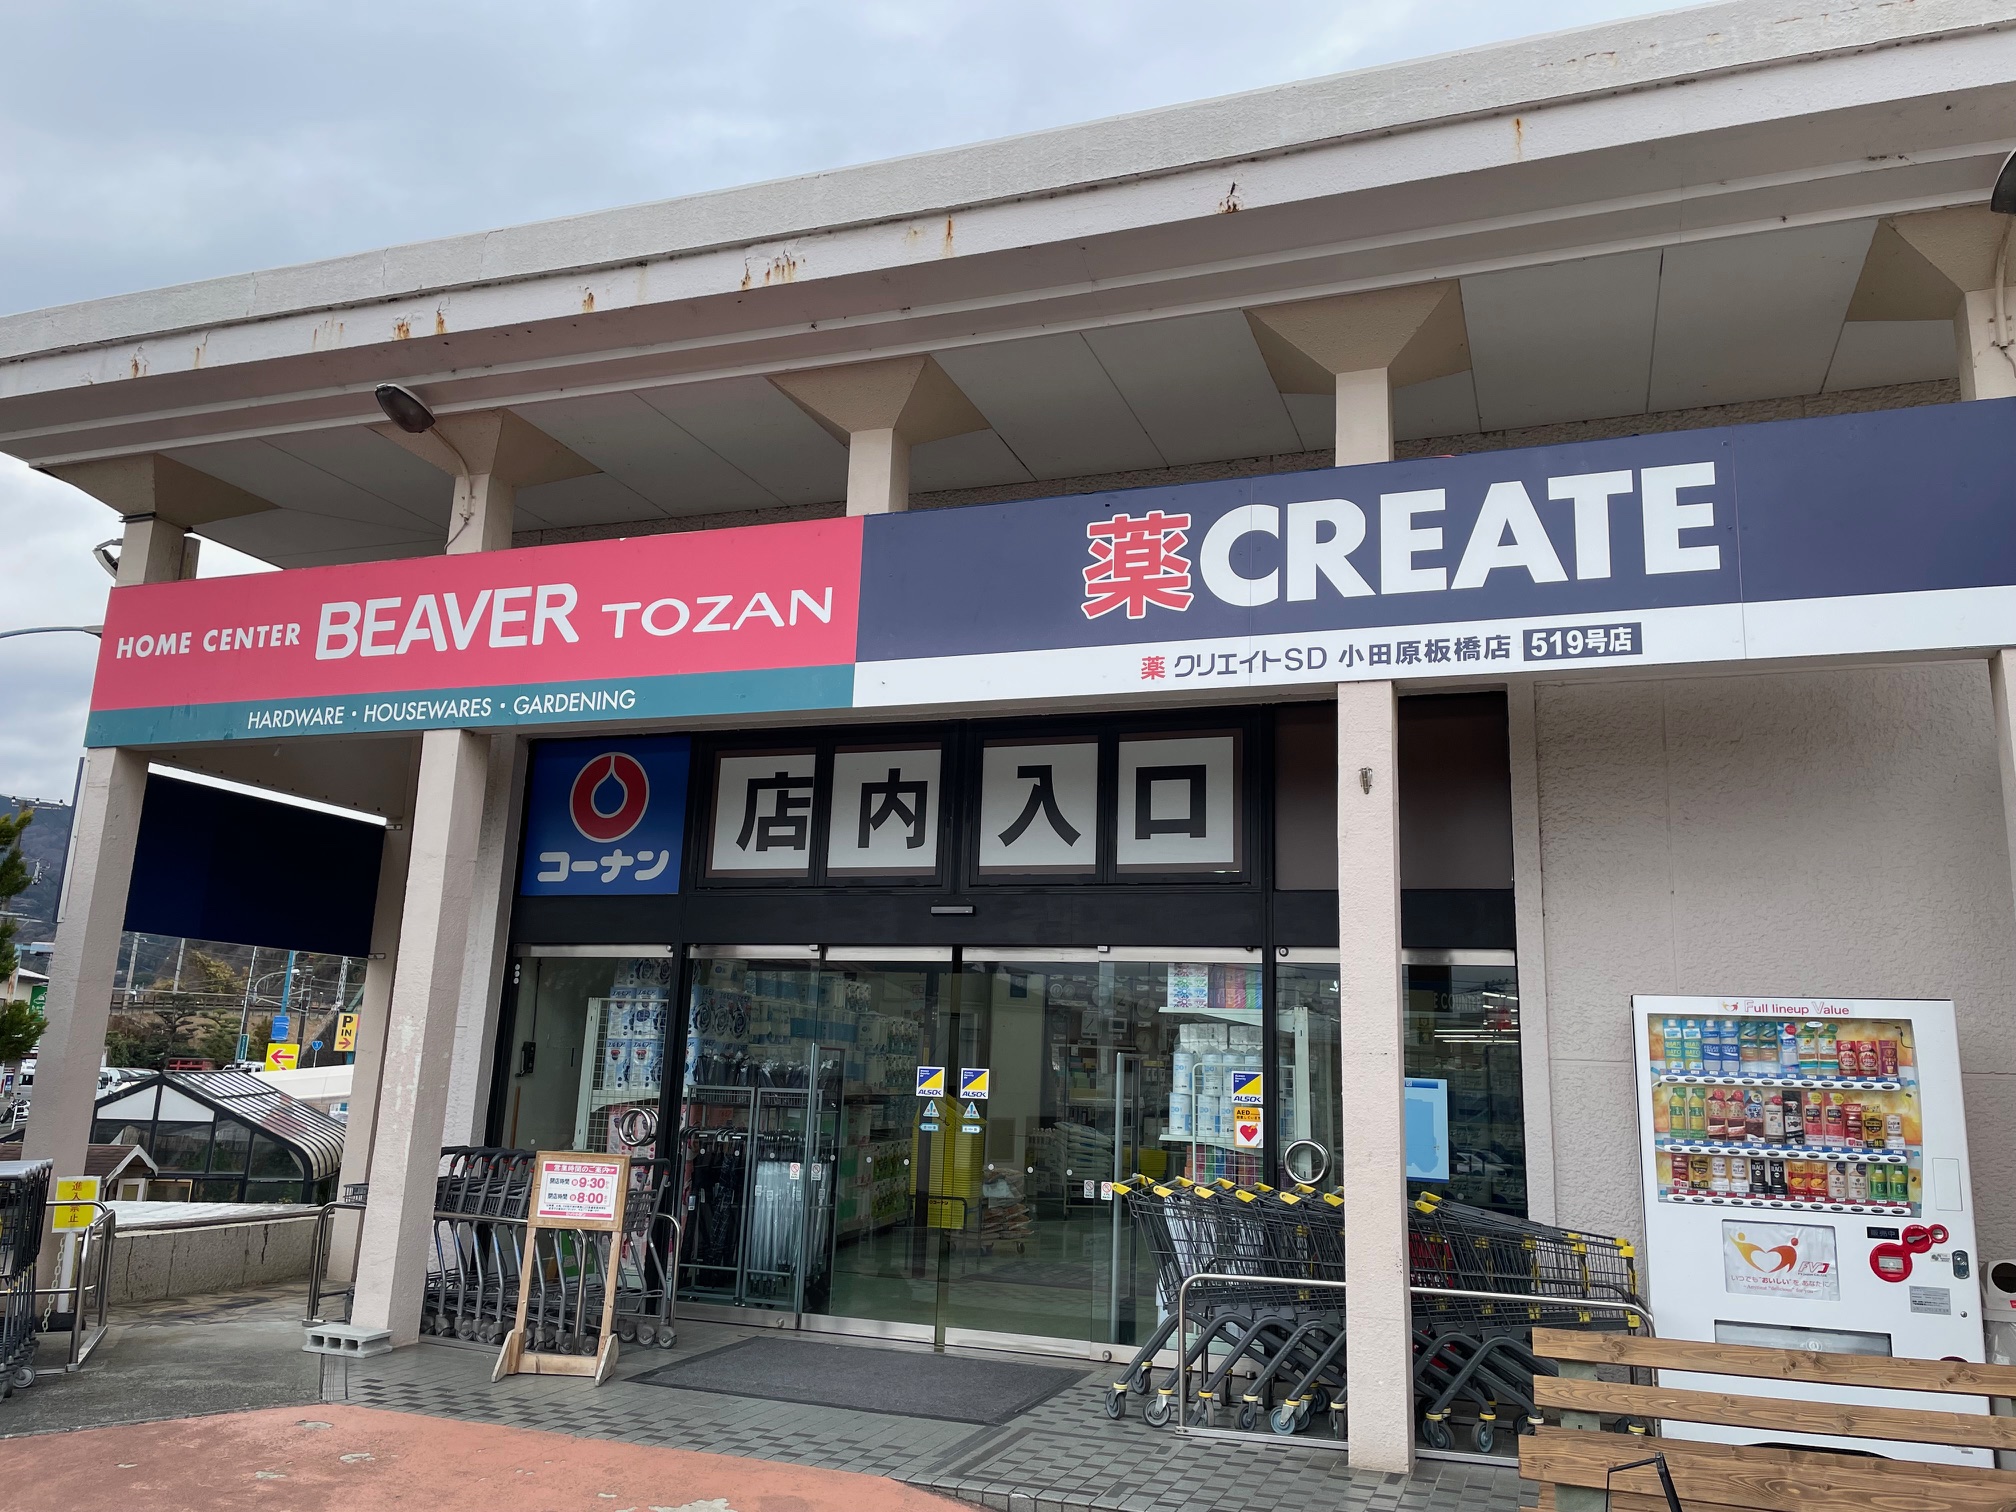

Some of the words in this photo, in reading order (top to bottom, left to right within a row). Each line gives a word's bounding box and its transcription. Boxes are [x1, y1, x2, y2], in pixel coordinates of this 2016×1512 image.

[1199, 461, 1721, 608] CREATE
[116, 632, 192, 658] HOME
[203, 623, 300, 652] CENTER
[315, 583, 579, 660] BEAVER
[601, 587, 833, 639] TOZAN
[1141, 656, 1165, 680] 薬
[1174, 647, 1327, 677] クリエイトSD
[1338, 635, 1511, 668] 小田原板橋店
[1531, 627, 1631, 657] 519号店
[247, 705, 345, 729] HARDWARE
[363, 698, 492, 722] HOUSEWARES
[513, 689, 636, 715] GARDENING
[537, 848, 669, 883] コーナン
[1744, 1000, 1768, 1013] Full
[1772, 1000, 1809, 1015] lineup
[1811, 1001, 1849, 1015] Value
[341, 1029, 352, 1037] IN
[343, 1015, 353, 1027] P
[579, 1177, 605, 1189] 9:30
[577, 1192, 603, 1204] 8:00
